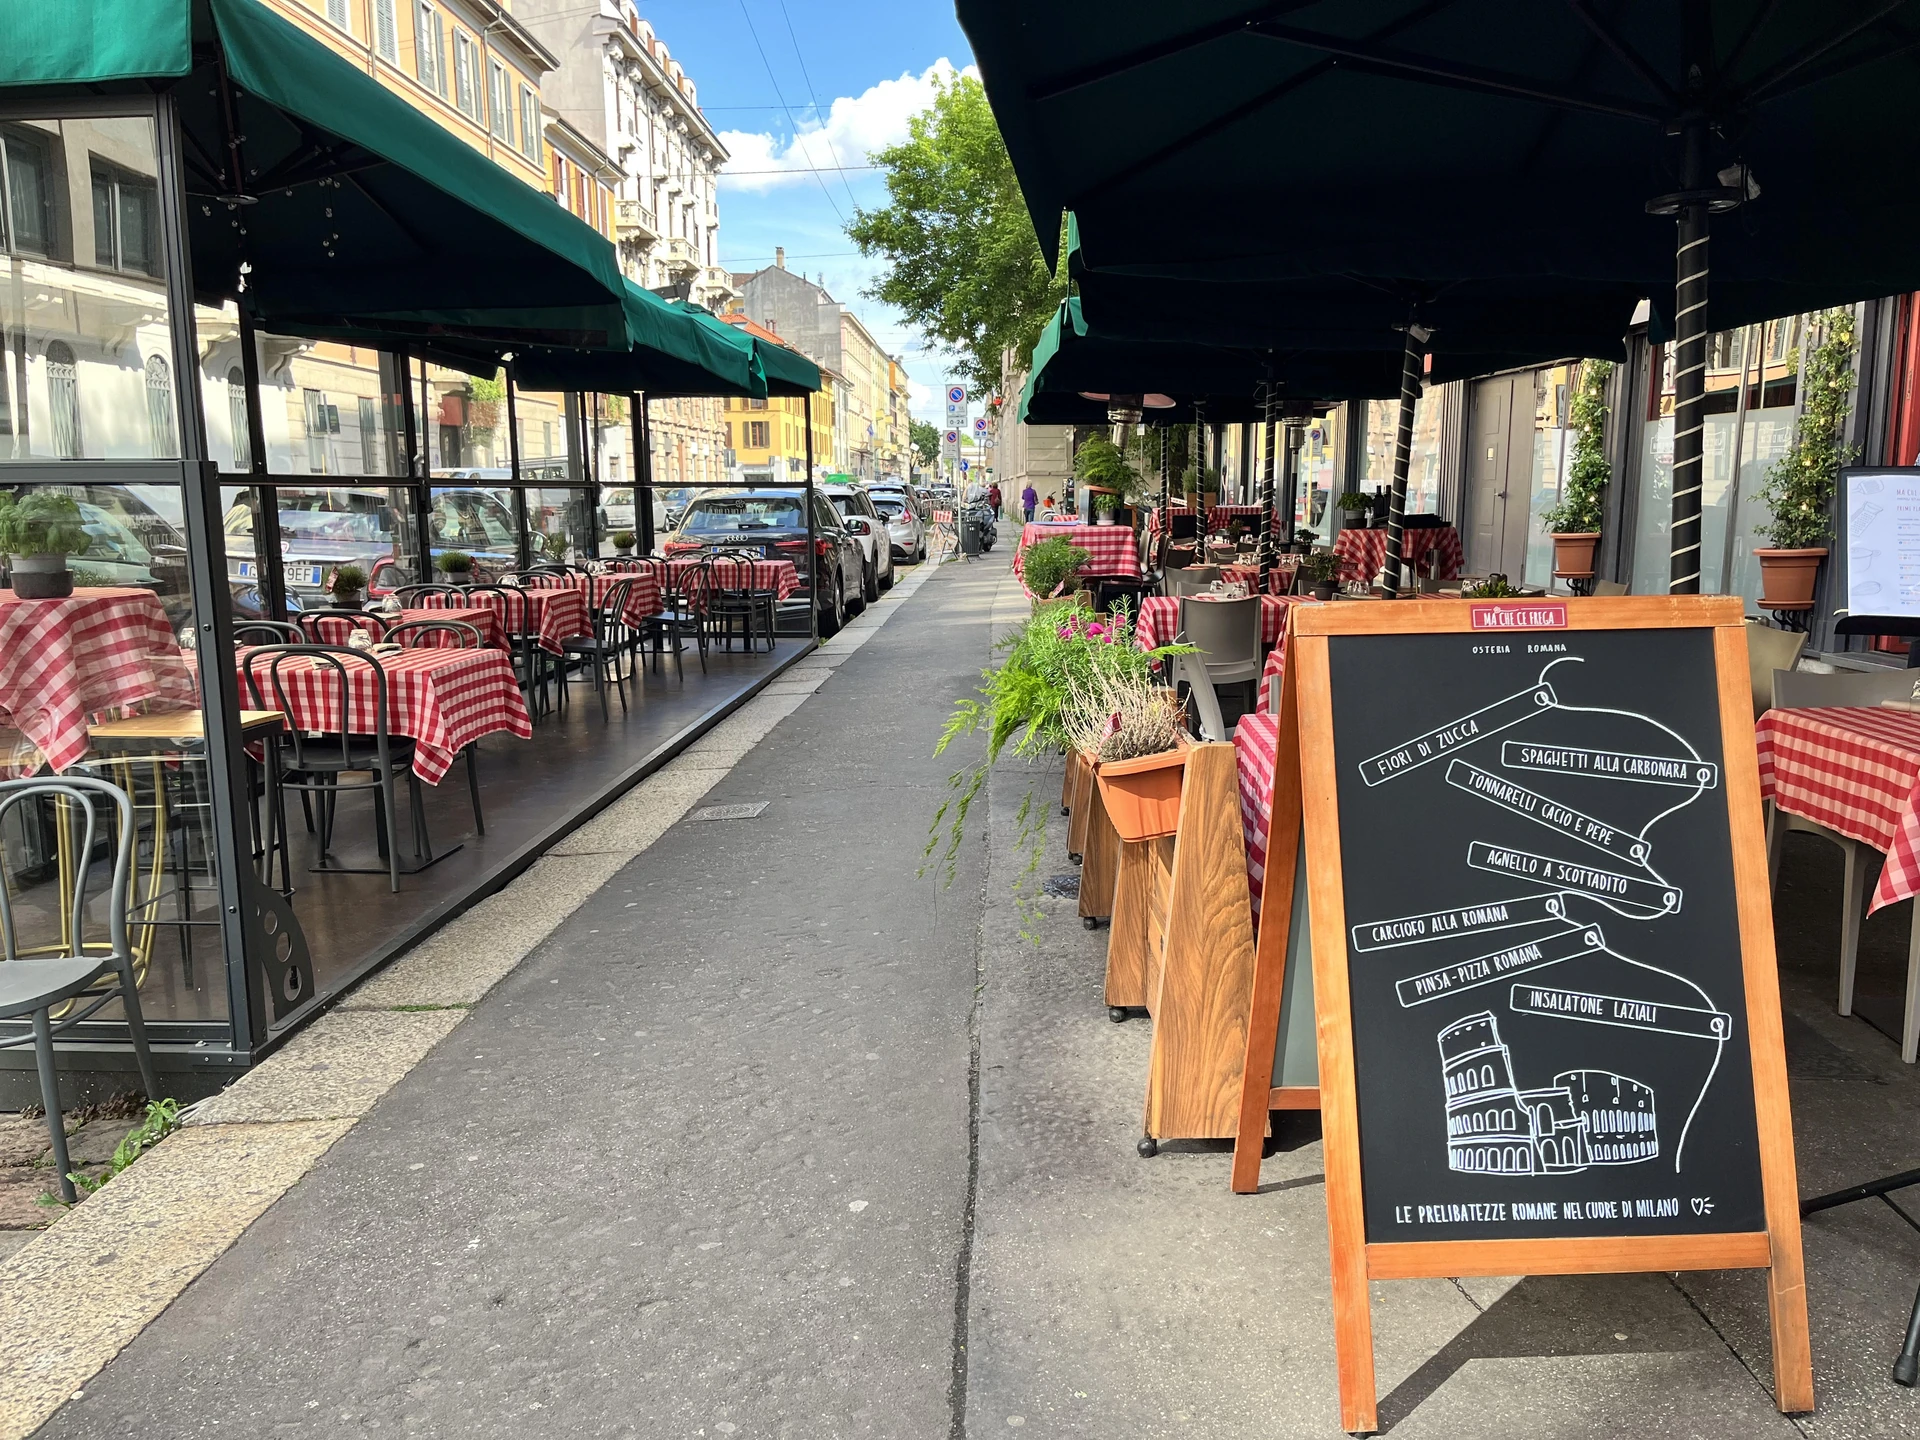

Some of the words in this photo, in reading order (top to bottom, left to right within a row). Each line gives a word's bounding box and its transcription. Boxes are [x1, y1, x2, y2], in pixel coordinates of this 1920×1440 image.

[1483, 612, 1497, 626] MA
[1499, 612, 1514, 626] CHE
[1517, 611, 1527, 625] CE
[1529, 611, 1554, 625] FREGA
[1472, 645, 1510, 654] OSTERIA
[1527, 643, 1567, 653] ROMANA
[1377, 750, 1413, 775] FIORI
[1417, 741, 1432, 757] DI
[1435, 719, 1480, 749] ZUCCA
[1521, 748, 1588, 769] SPAGHETTI
[1593, 754, 1619, 773] ALLA
[1623, 758, 1687, 779] CARBONARA
[1468, 770, 1537, 812] TONNARELLI
[1541, 803, 1573, 827] CACIO
[1574, 817, 1584, 832] E
[1585, 822, 1614, 846] PEPE
[1486, 849, 1538, 874] AGNELLO
[1542, 862, 1552, 877] A
[1556, 865, 1627, 894] SCOTTADITO
[1372, 920, 1425, 942] CARCIOFO
[1431, 914, 1458, 933] ALLA
[1461, 905, 1509, 927] ROMANA
[1493, 943, 1543, 972] ROMANA
[1530, 990, 1603, 1015] INSALATONE
[1613, 1001, 1656, 1023] LAZIALI
[1395, 1205, 1412, 1224] LE
[1418, 1203, 1507, 1224] PRELIBATEZZE
[1511, 1202, 1558, 1220] ROMANE
[1563, 1201, 1584, 1220] NEL
[1585, 1201, 1618, 1219] CUORE
[1621, 1200, 1633, 1218] DI
[1635, 1197, 1679, 1218] MILANO
